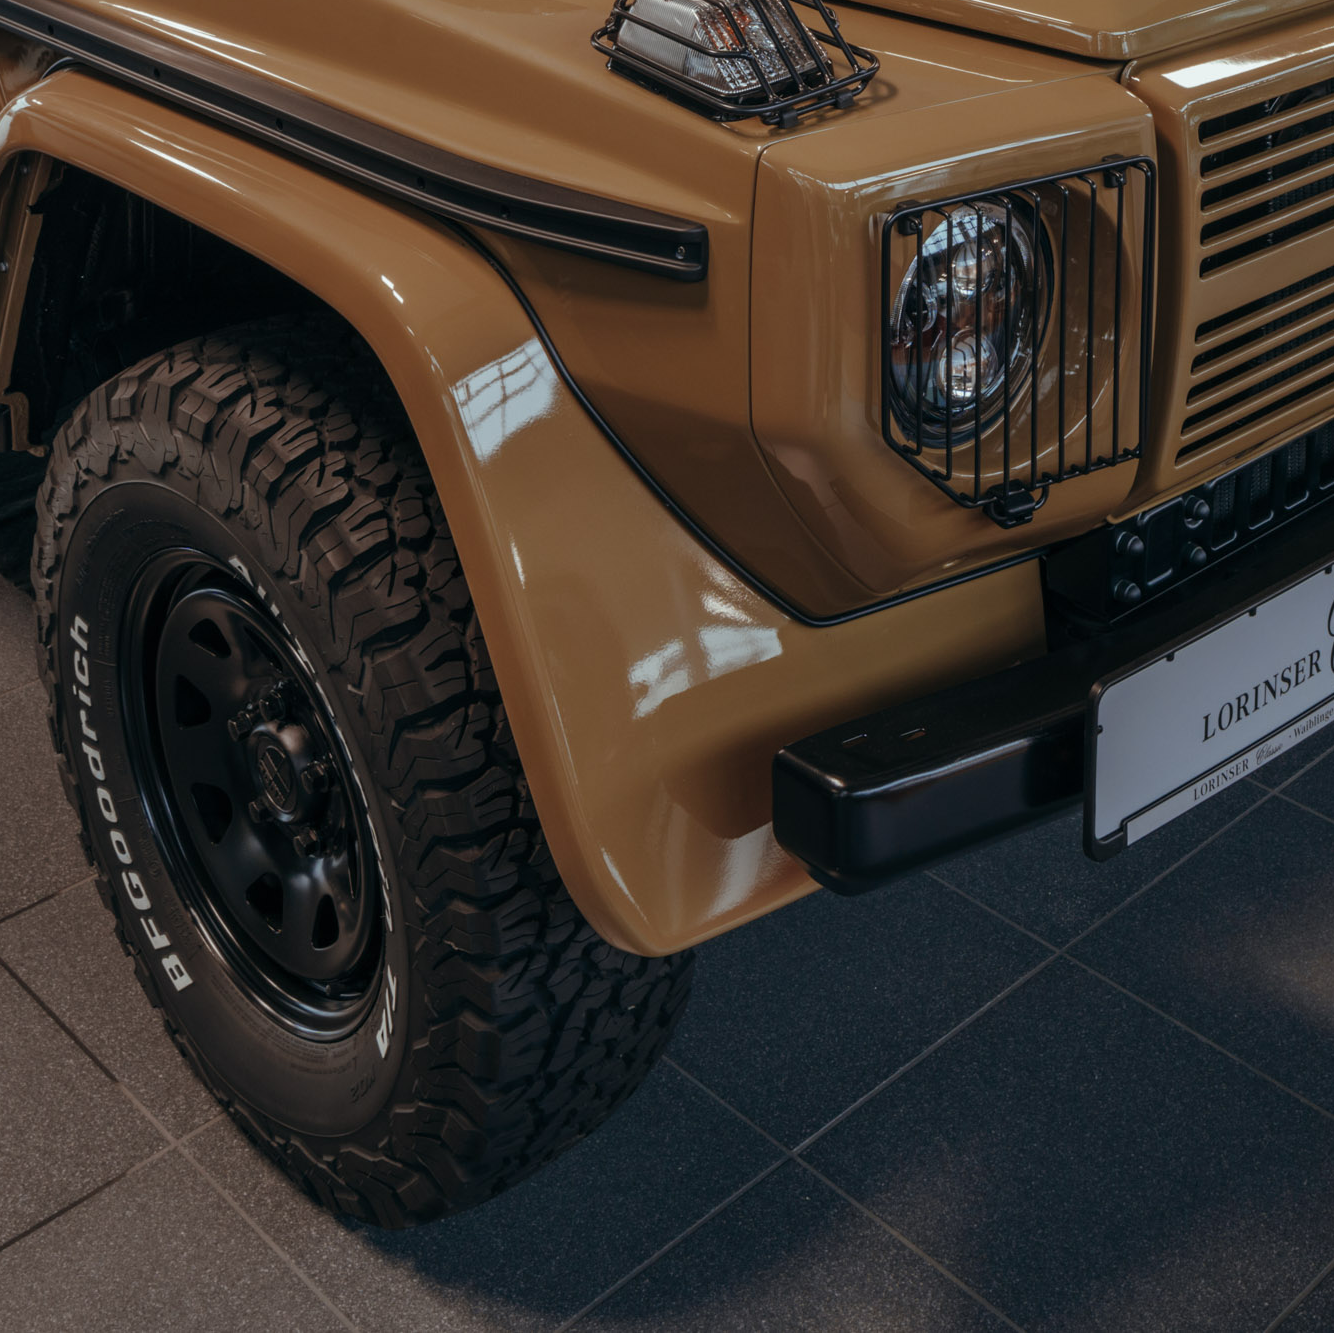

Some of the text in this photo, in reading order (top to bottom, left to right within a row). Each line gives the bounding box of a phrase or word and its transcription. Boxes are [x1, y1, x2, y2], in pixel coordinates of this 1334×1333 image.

[1202, 649, 1321, 743] LORINSER
[69, 615, 194, 992] BFGoodrich
[1193, 758, 1250, 801] LORINSER
